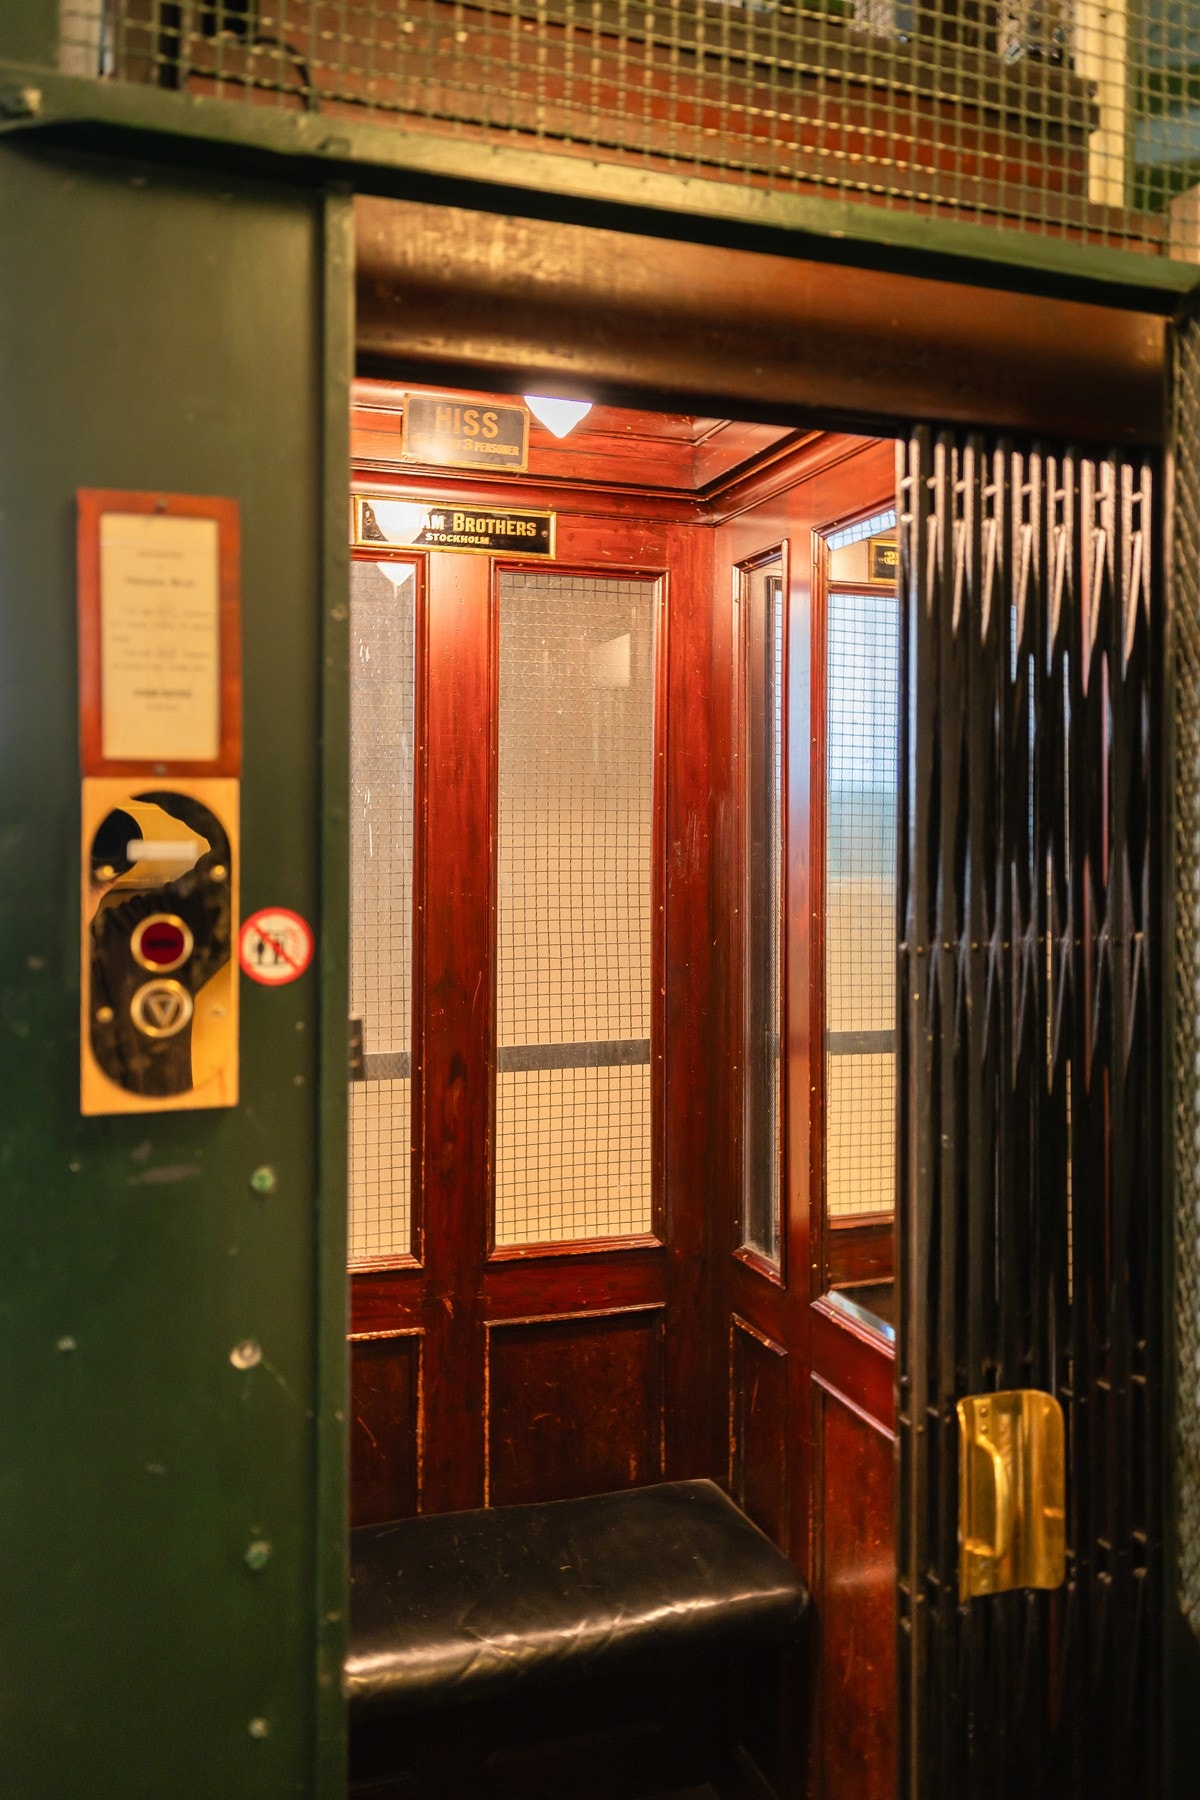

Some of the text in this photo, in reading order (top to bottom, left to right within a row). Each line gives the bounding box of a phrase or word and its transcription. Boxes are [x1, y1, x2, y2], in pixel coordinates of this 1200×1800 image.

[434, 406, 499, 439] HISS
[463, 438, 474, 451] 3
[453, 512, 537, 537] BROTHERS
